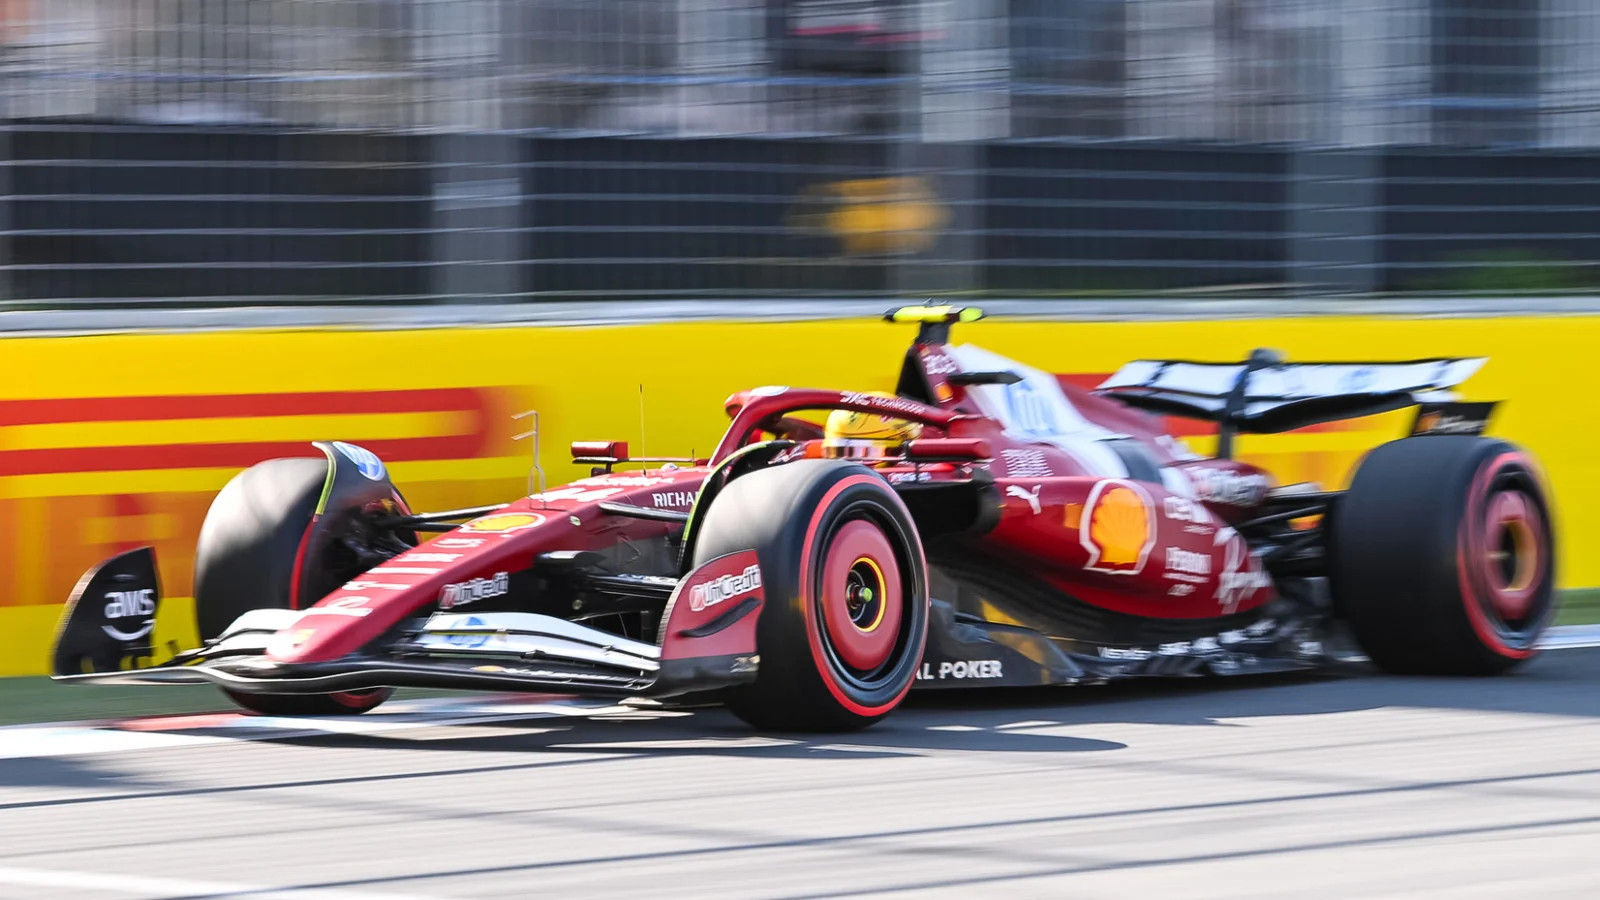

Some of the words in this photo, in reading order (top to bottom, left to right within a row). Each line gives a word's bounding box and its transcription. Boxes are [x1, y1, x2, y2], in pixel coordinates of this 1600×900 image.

[652, 491, 700, 507] RICHA
[104, 588, 155, 619] aws
[939, 660, 1003, 679] POKER
